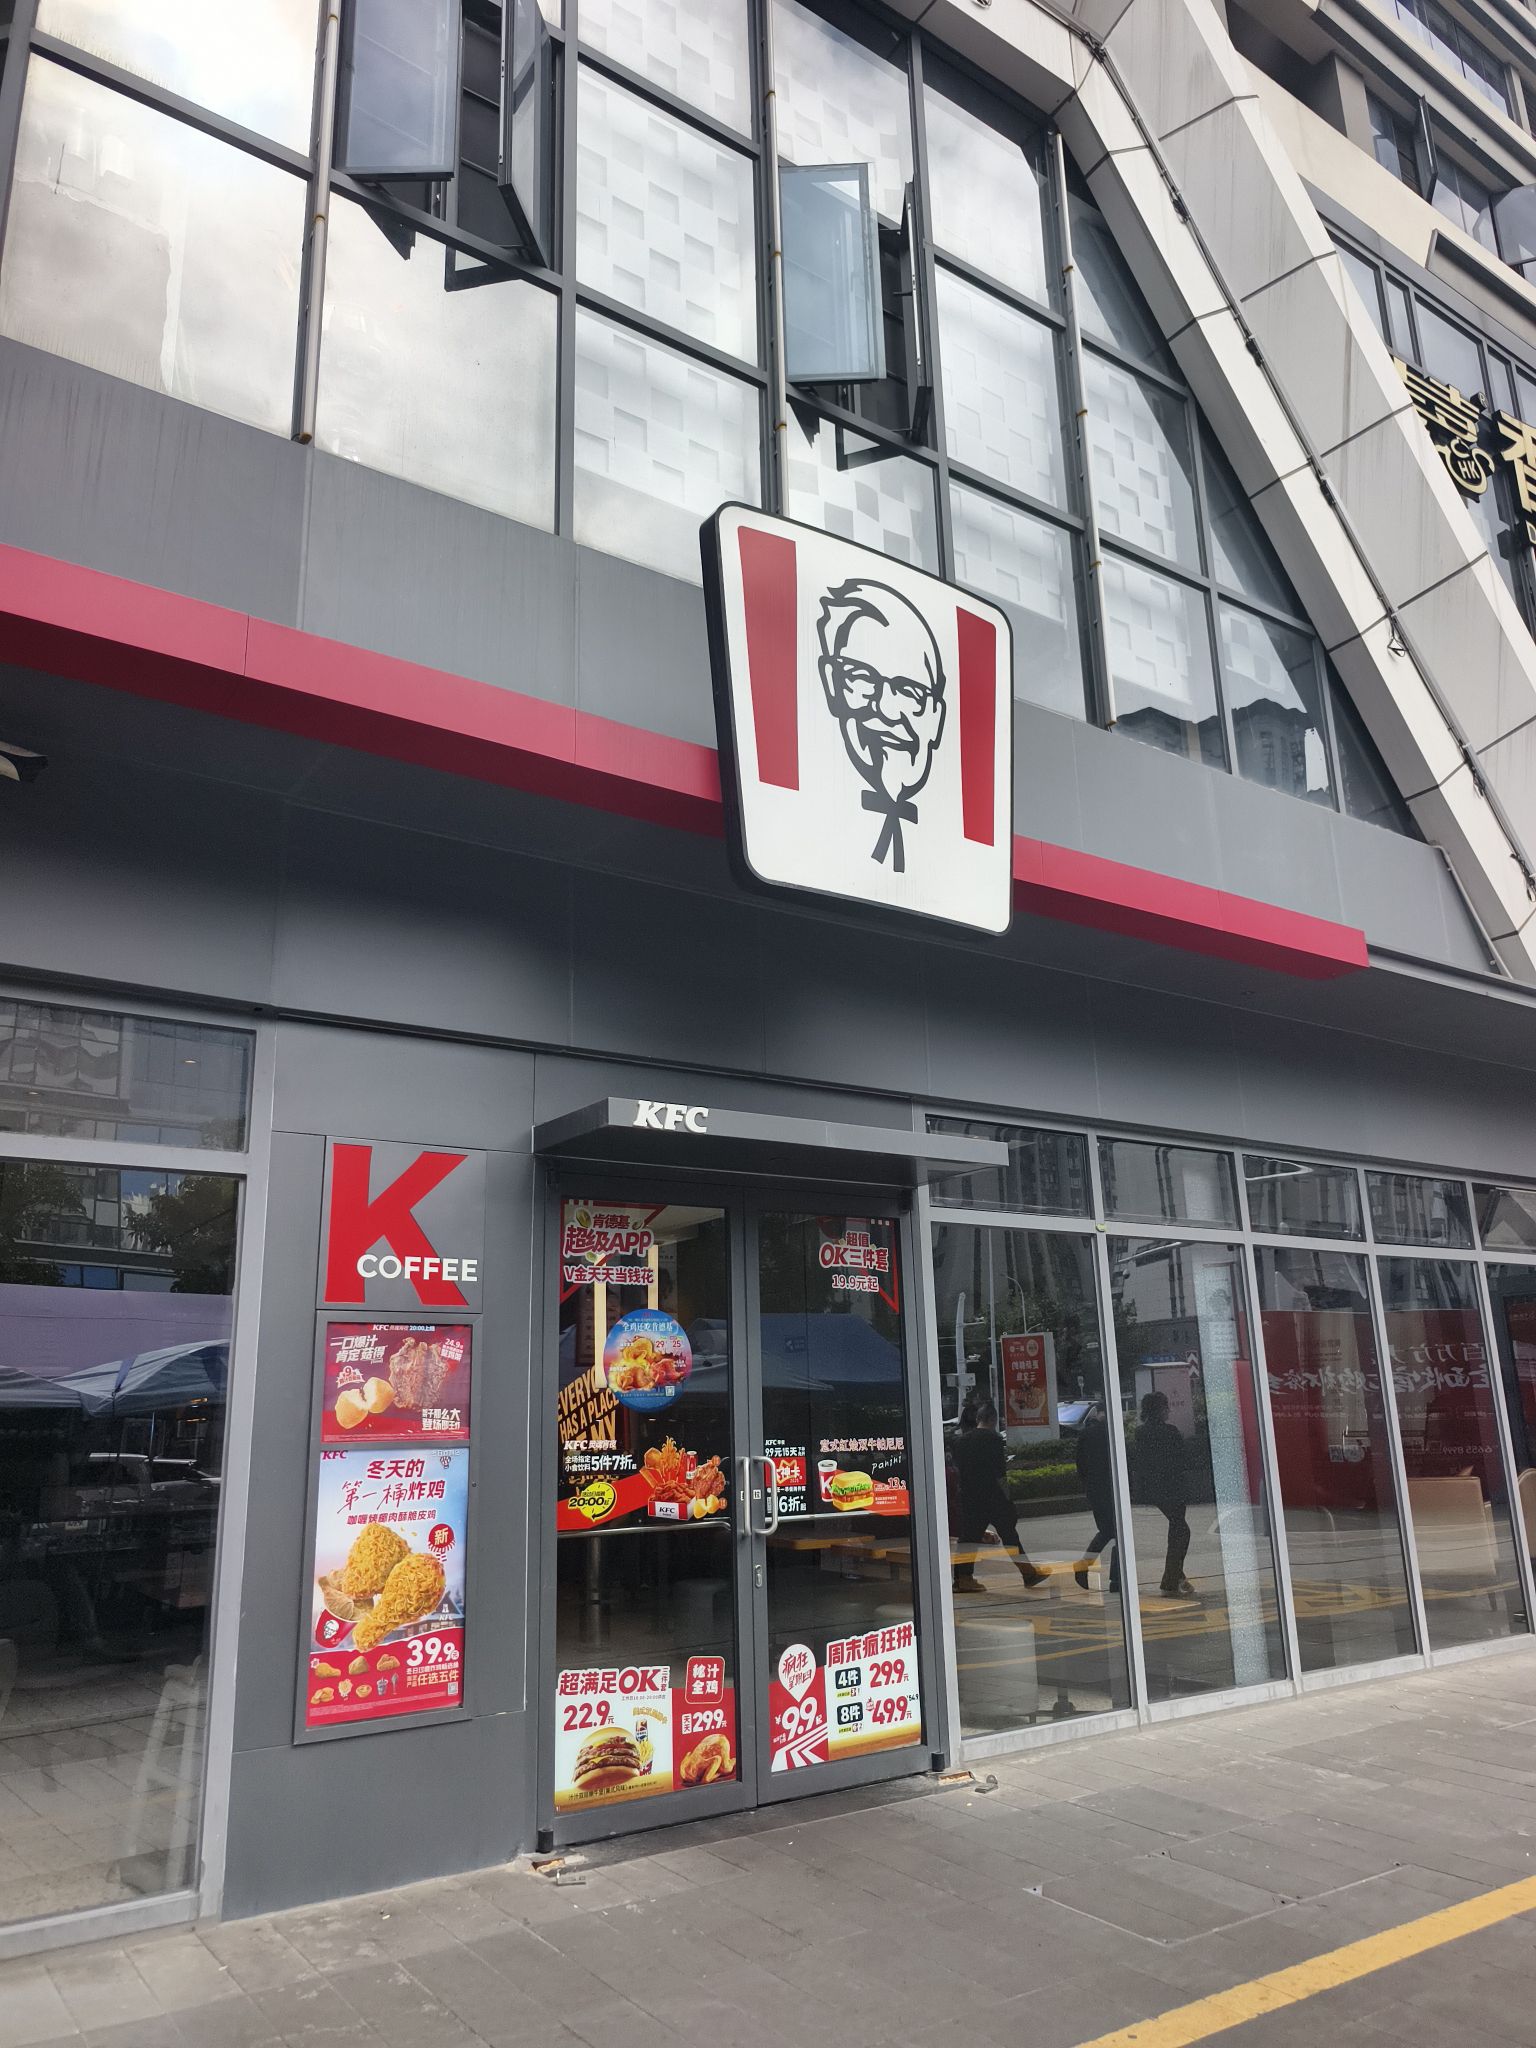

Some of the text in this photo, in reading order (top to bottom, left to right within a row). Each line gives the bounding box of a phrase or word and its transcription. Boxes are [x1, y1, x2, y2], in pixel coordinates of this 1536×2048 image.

[633, 1100, 709, 1133] KFC
[325, 1142, 469, 1305] K
[592, 1213, 630, 1229] 肯德基
[564, 1225, 653, 1255] 超级APP
[846, 1232, 869, 1247] 超值
[357, 1254, 478, 1281] COFFEE
[820, 1243, 888, 1271] OK三件套
[564, 1266, 654, 1283] V金天天当钱花
[832, 1274, 879, 1291] 19.9元起
[558, 1364, 600, 1422] VERYO
[560, 1413, 579, 1444] HAS
[580, 1407, 588, 1429] A
[322, 1450, 347, 1460] KFC
[564, 1440, 588, 1450] KFC
[367, 1459, 425, 1479] 冬天的
[565, 1455, 591, 1464] 全场指定
[565, 1463, 591, 1472] 小食饮料
[434, 1527, 449, 1545] 新
[828, 1623, 913, 1667] 周末疯狂拼
[418, 1669, 459, 1687] 任选五件
[559, 1669, 661, 1696] 超满足OK
[838, 1659, 909, 1688] 4件 29.9元
[563, 1700, 615, 1732] 22.9元
[840, 1696, 912, 1724] 8件 49.9元
